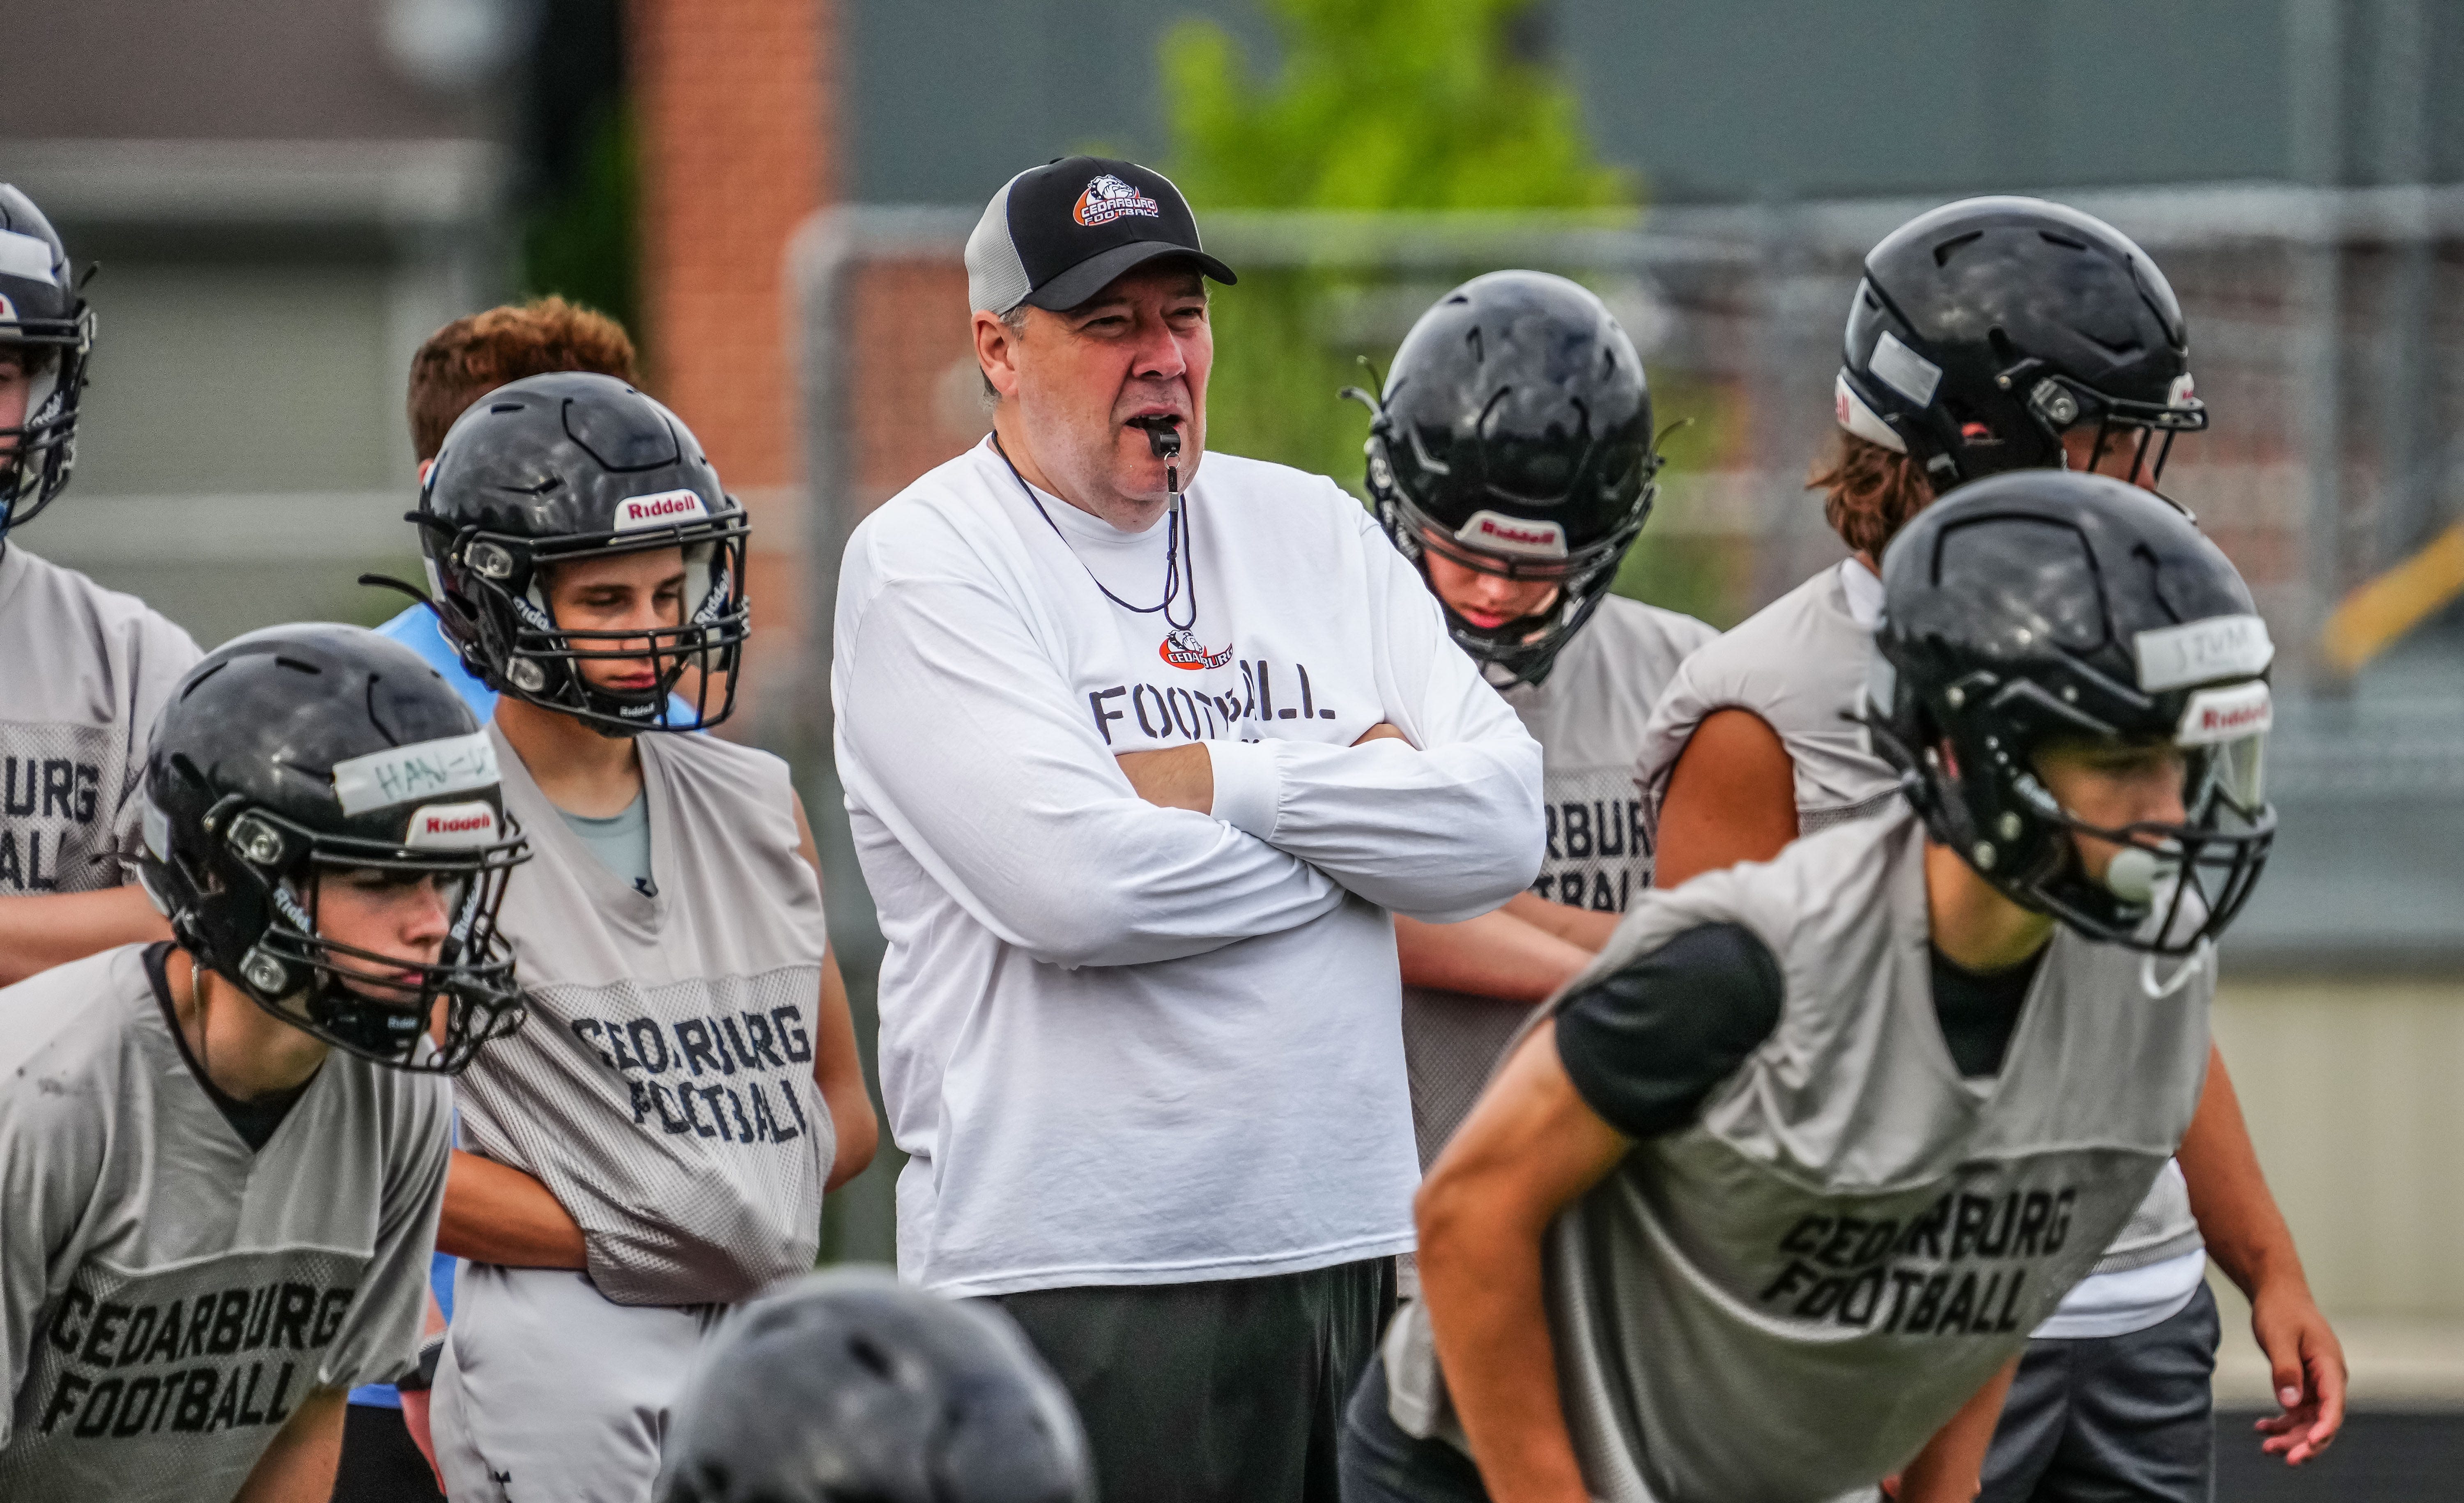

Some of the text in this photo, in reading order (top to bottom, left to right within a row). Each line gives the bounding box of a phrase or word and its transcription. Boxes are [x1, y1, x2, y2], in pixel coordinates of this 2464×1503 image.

[1081, 198, 1156, 217] CEDARBURG
[1084, 209, 1159, 226] FOOTBALL
[628, 496, 695, 519] Riddell
[49, 1282, 356, 1367] CEDARBURG
[39, 1362, 294, 1437] FOOTBALL
